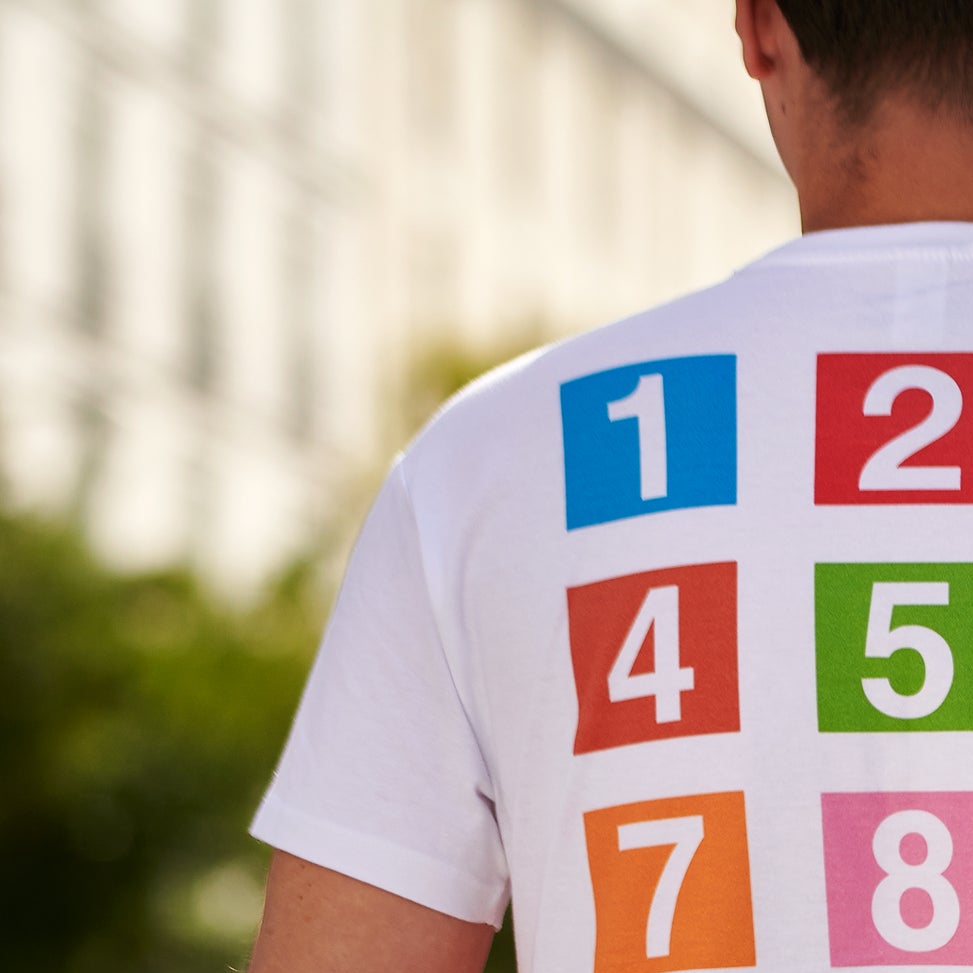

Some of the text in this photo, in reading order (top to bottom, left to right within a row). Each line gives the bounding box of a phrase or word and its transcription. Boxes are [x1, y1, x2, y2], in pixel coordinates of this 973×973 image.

[606, 372, 668, 501] 1
[858, 364, 964, 491] 2
[607, 584, 695, 723] 4
[861, 581, 955, 720] 5
[617, 814, 706, 959] 7
[871, 809, 961, 954] 8
